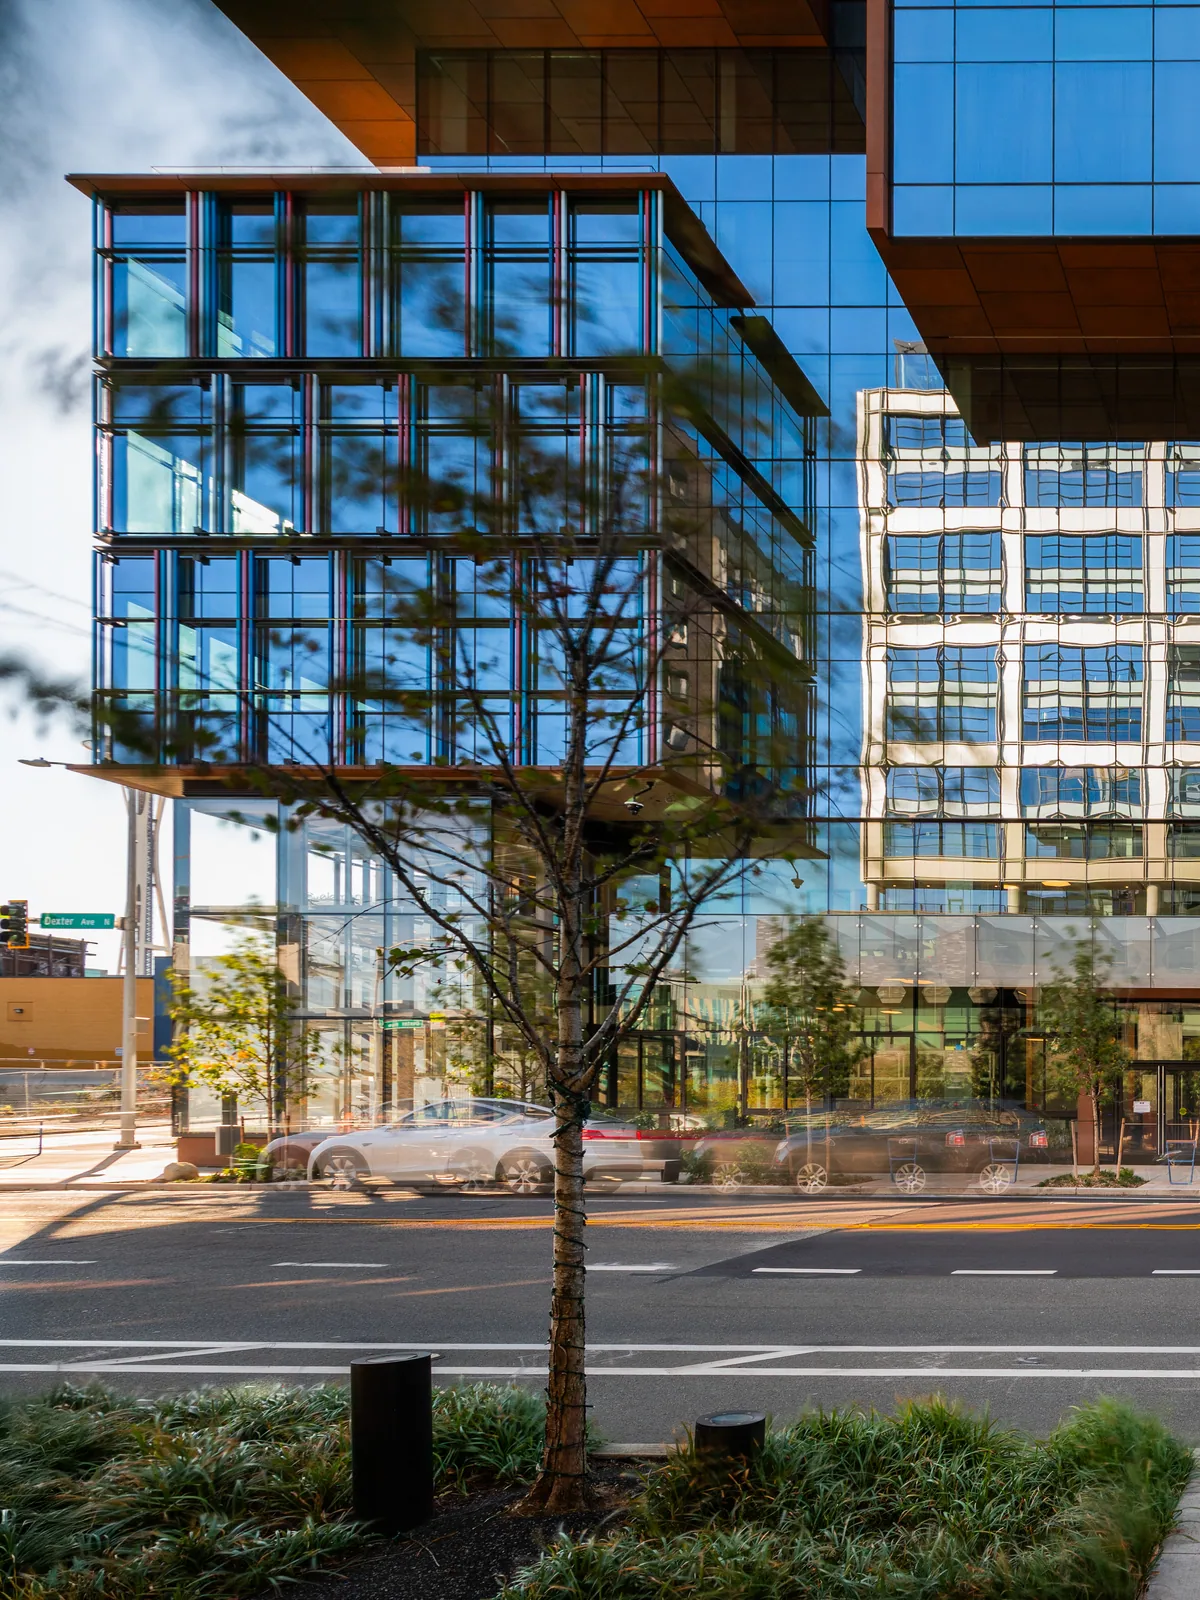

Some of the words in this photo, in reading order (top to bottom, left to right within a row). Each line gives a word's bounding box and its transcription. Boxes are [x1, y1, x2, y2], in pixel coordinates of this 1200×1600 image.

[44, 916, 74, 926] Dexter
[81, 918, 95, 926] Ave
[104, 918, 110, 926] N
